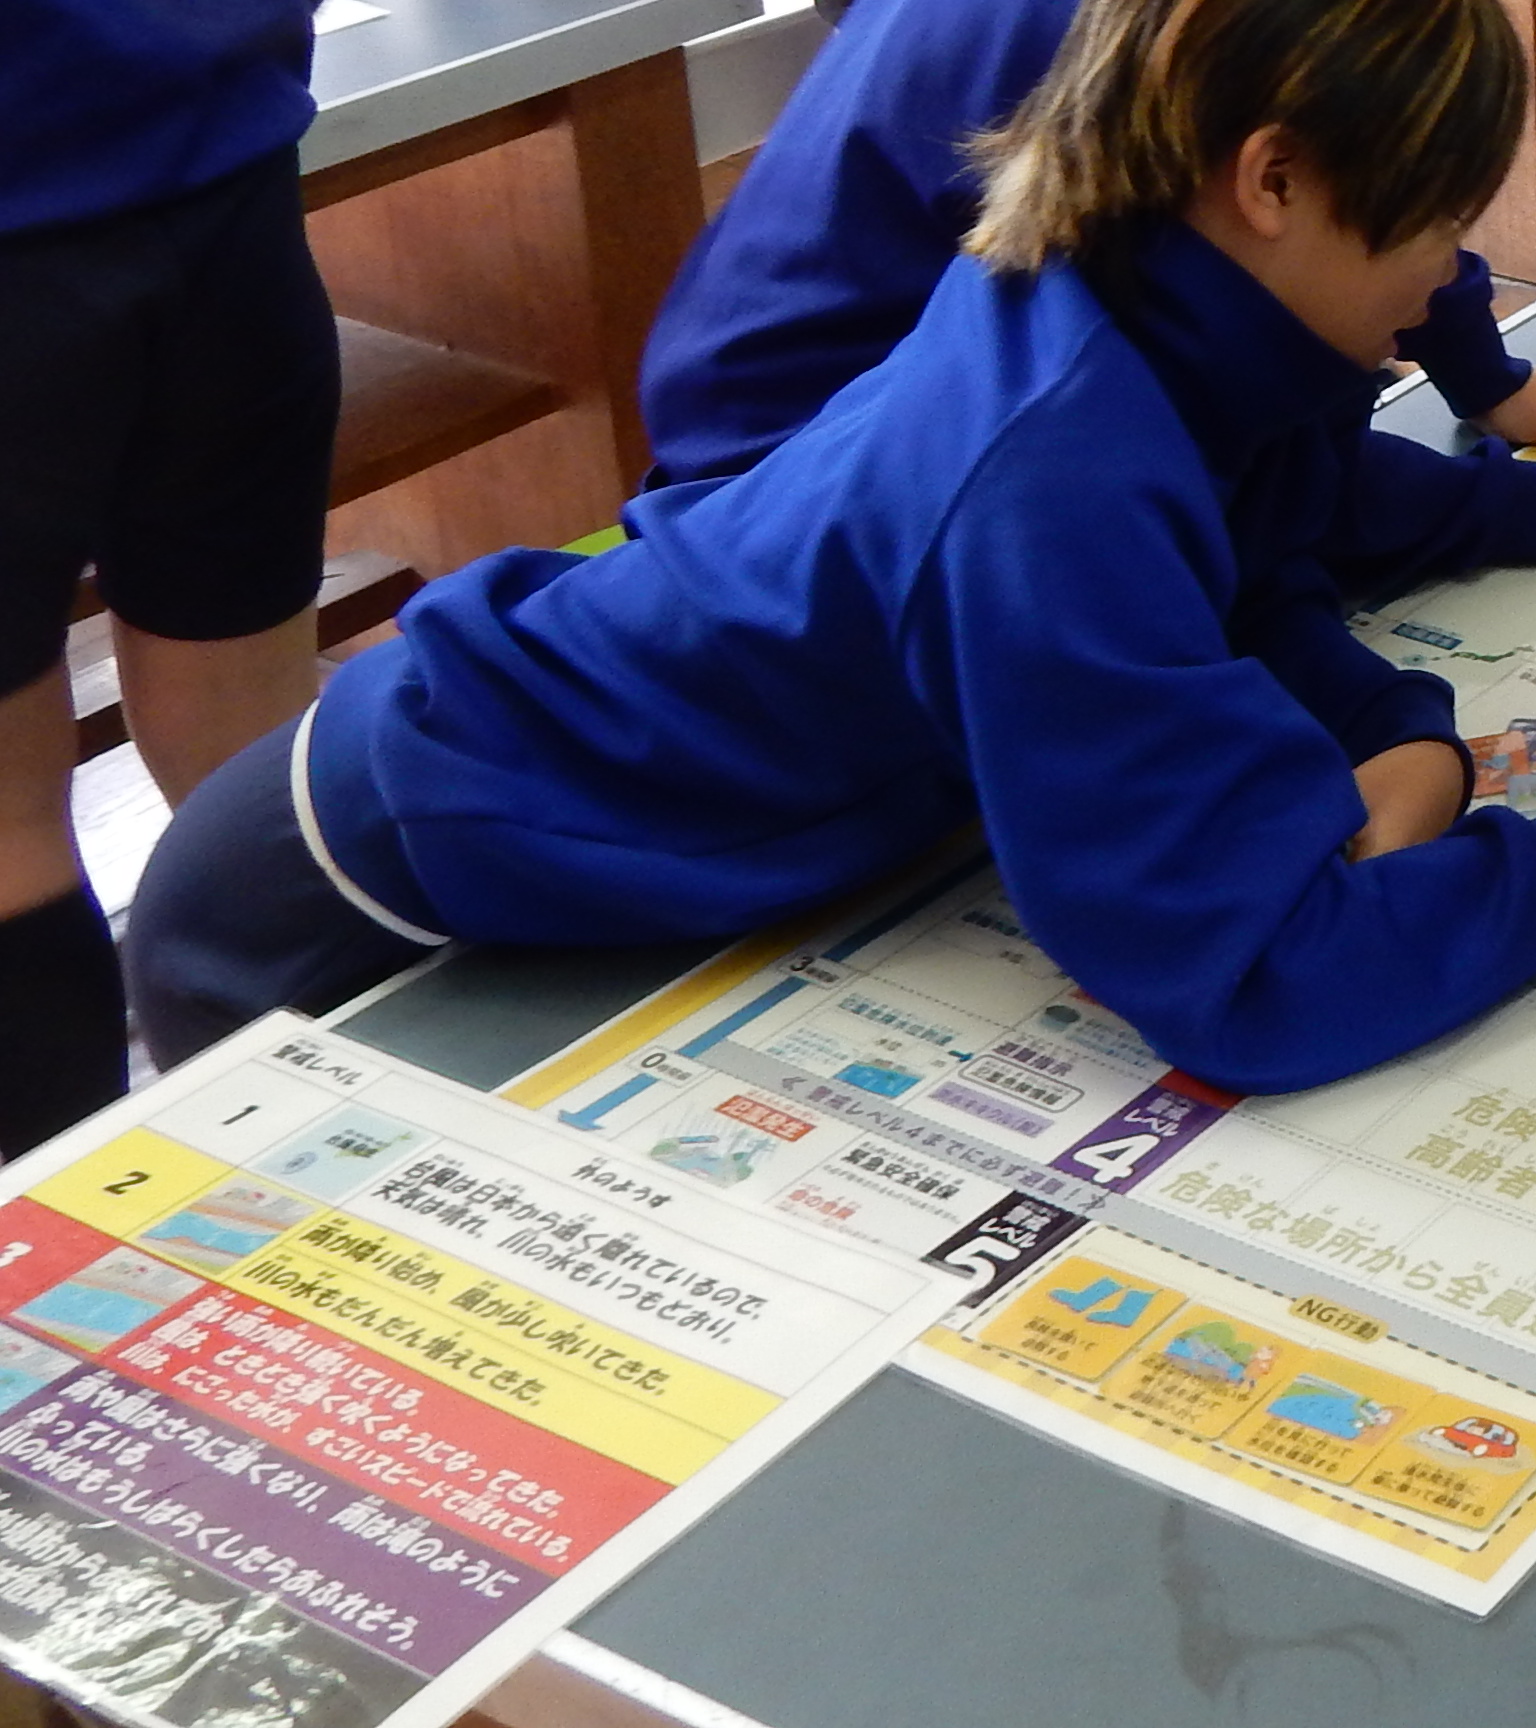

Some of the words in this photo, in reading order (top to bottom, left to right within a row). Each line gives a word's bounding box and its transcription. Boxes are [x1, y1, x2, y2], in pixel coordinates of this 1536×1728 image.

[220, 1103, 261, 1126] 1
[1073, 1132, 1167, 1185] 4
[101, 1168, 153, 1196] 2
[570, 1162, 675, 1210] 外のようす
[979, 1219, 1038, 1251] レベル
[241, 1258, 561, 1407] 川の水もだんだん増えてきた。
[1296, 1297, 1380, 1340] NG行動
